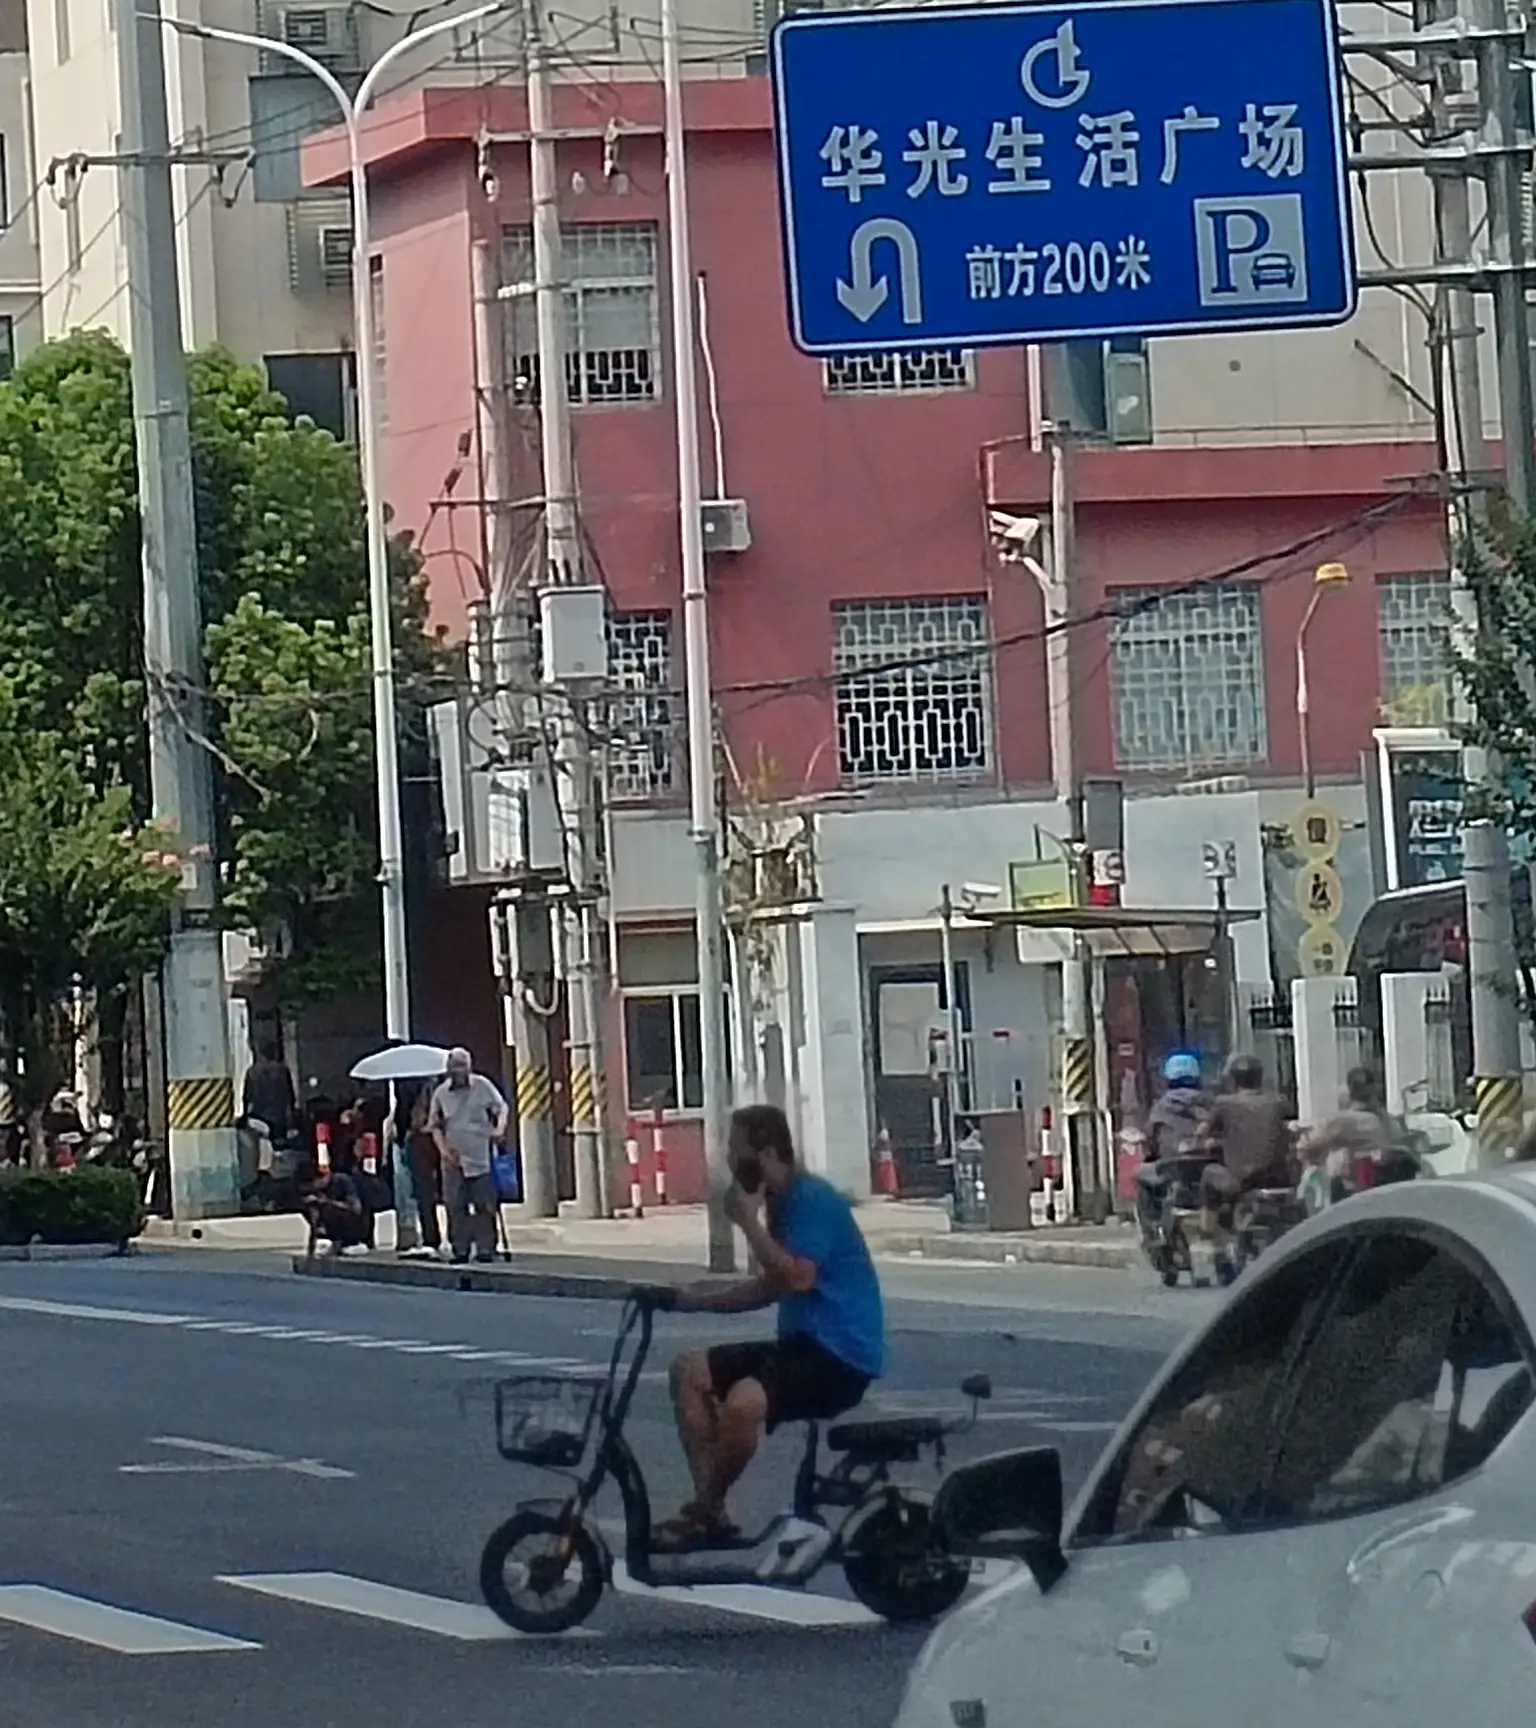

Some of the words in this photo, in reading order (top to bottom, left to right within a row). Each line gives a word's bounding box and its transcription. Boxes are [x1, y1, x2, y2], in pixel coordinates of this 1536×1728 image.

[819, 102, 1305, 204] 华光生活广场
[965, 235, 1152, 300] 前方200米
